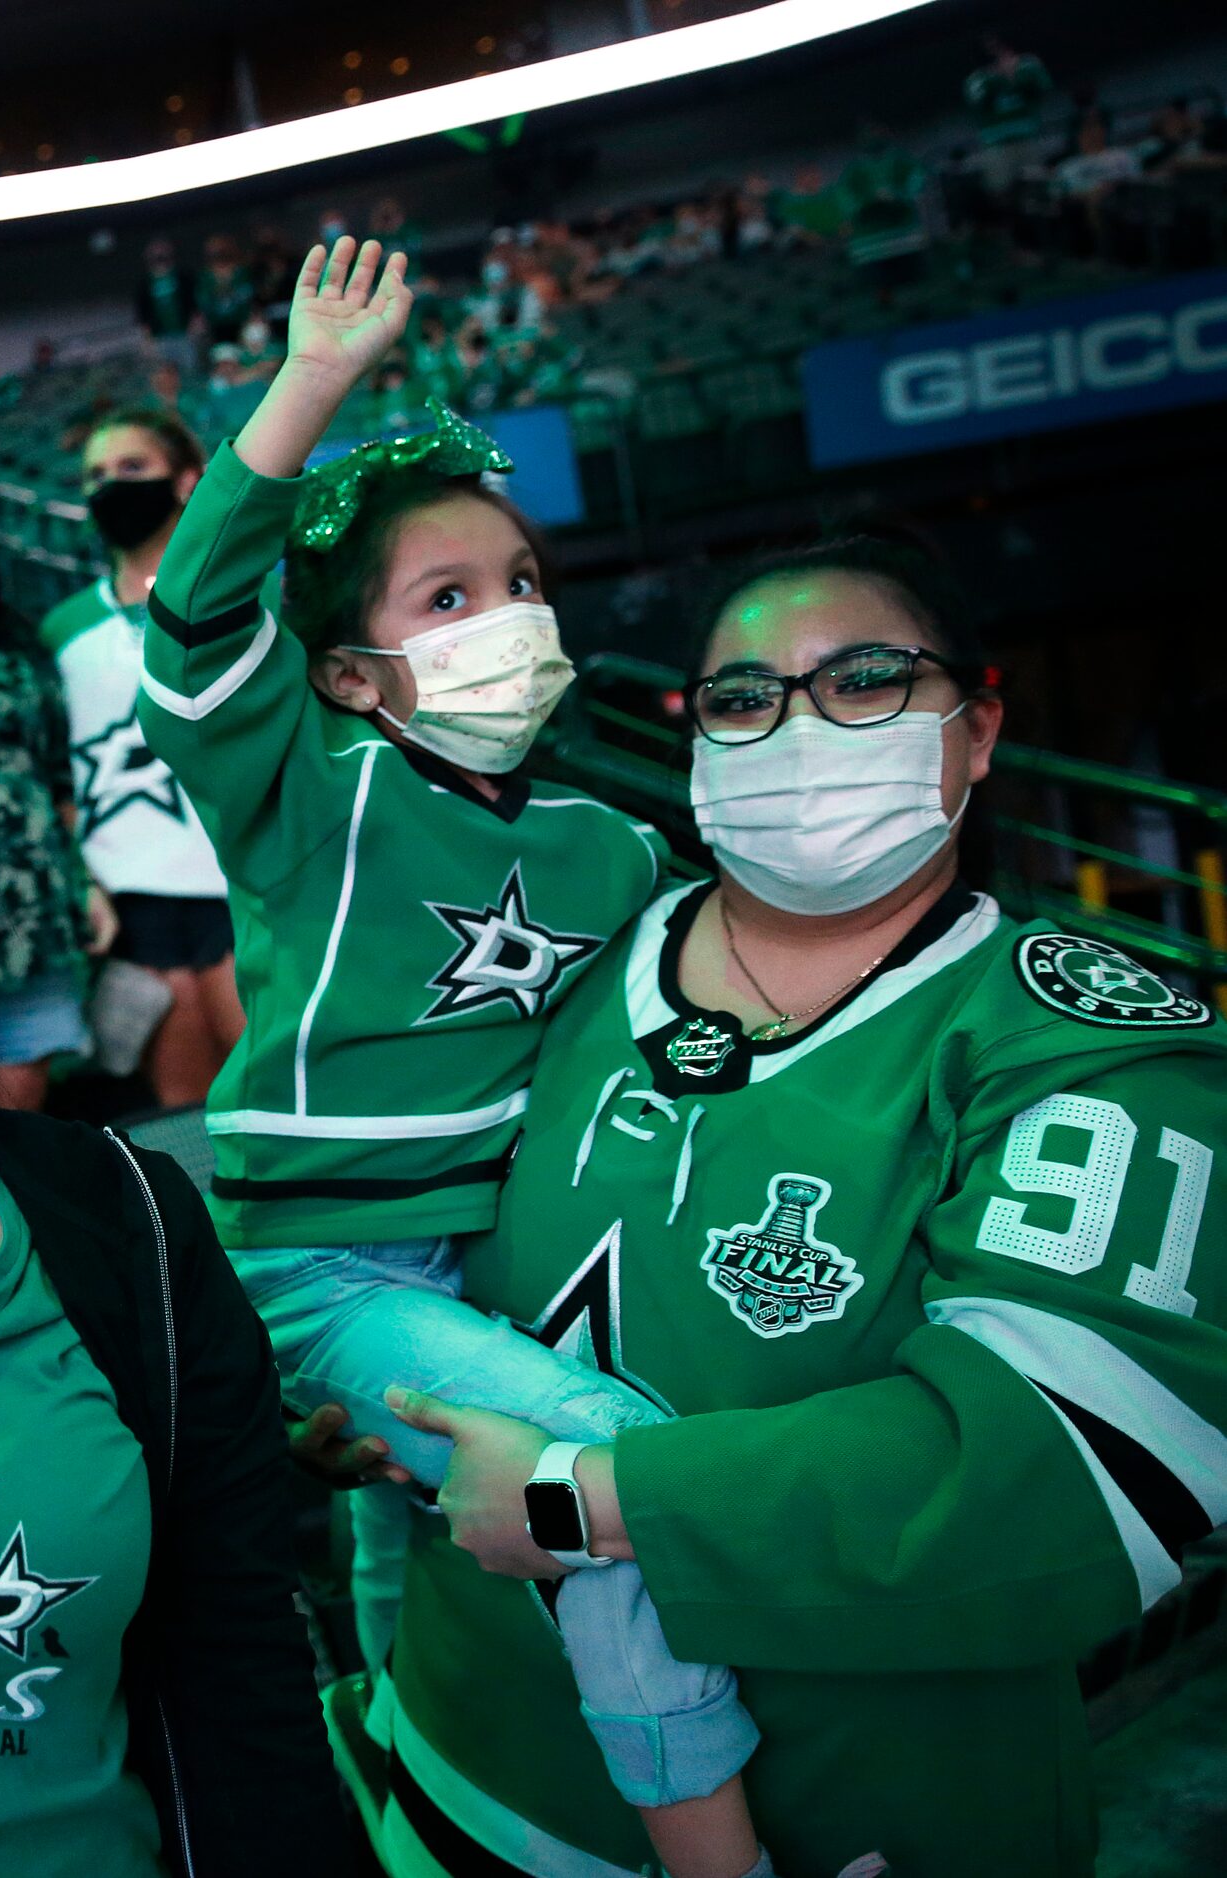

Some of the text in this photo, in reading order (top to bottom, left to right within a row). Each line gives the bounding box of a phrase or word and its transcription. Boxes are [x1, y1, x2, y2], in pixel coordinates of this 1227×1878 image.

[1075, 996, 1198, 1018] STARS
[975, 1092, 1214, 1318] 91
[736, 1234, 830, 1263] STANLEY CUP
[716, 1242, 844, 1289] FINAL
[750, 1276, 799, 1294] 2020
[758, 1303, 779, 1320] NHL
